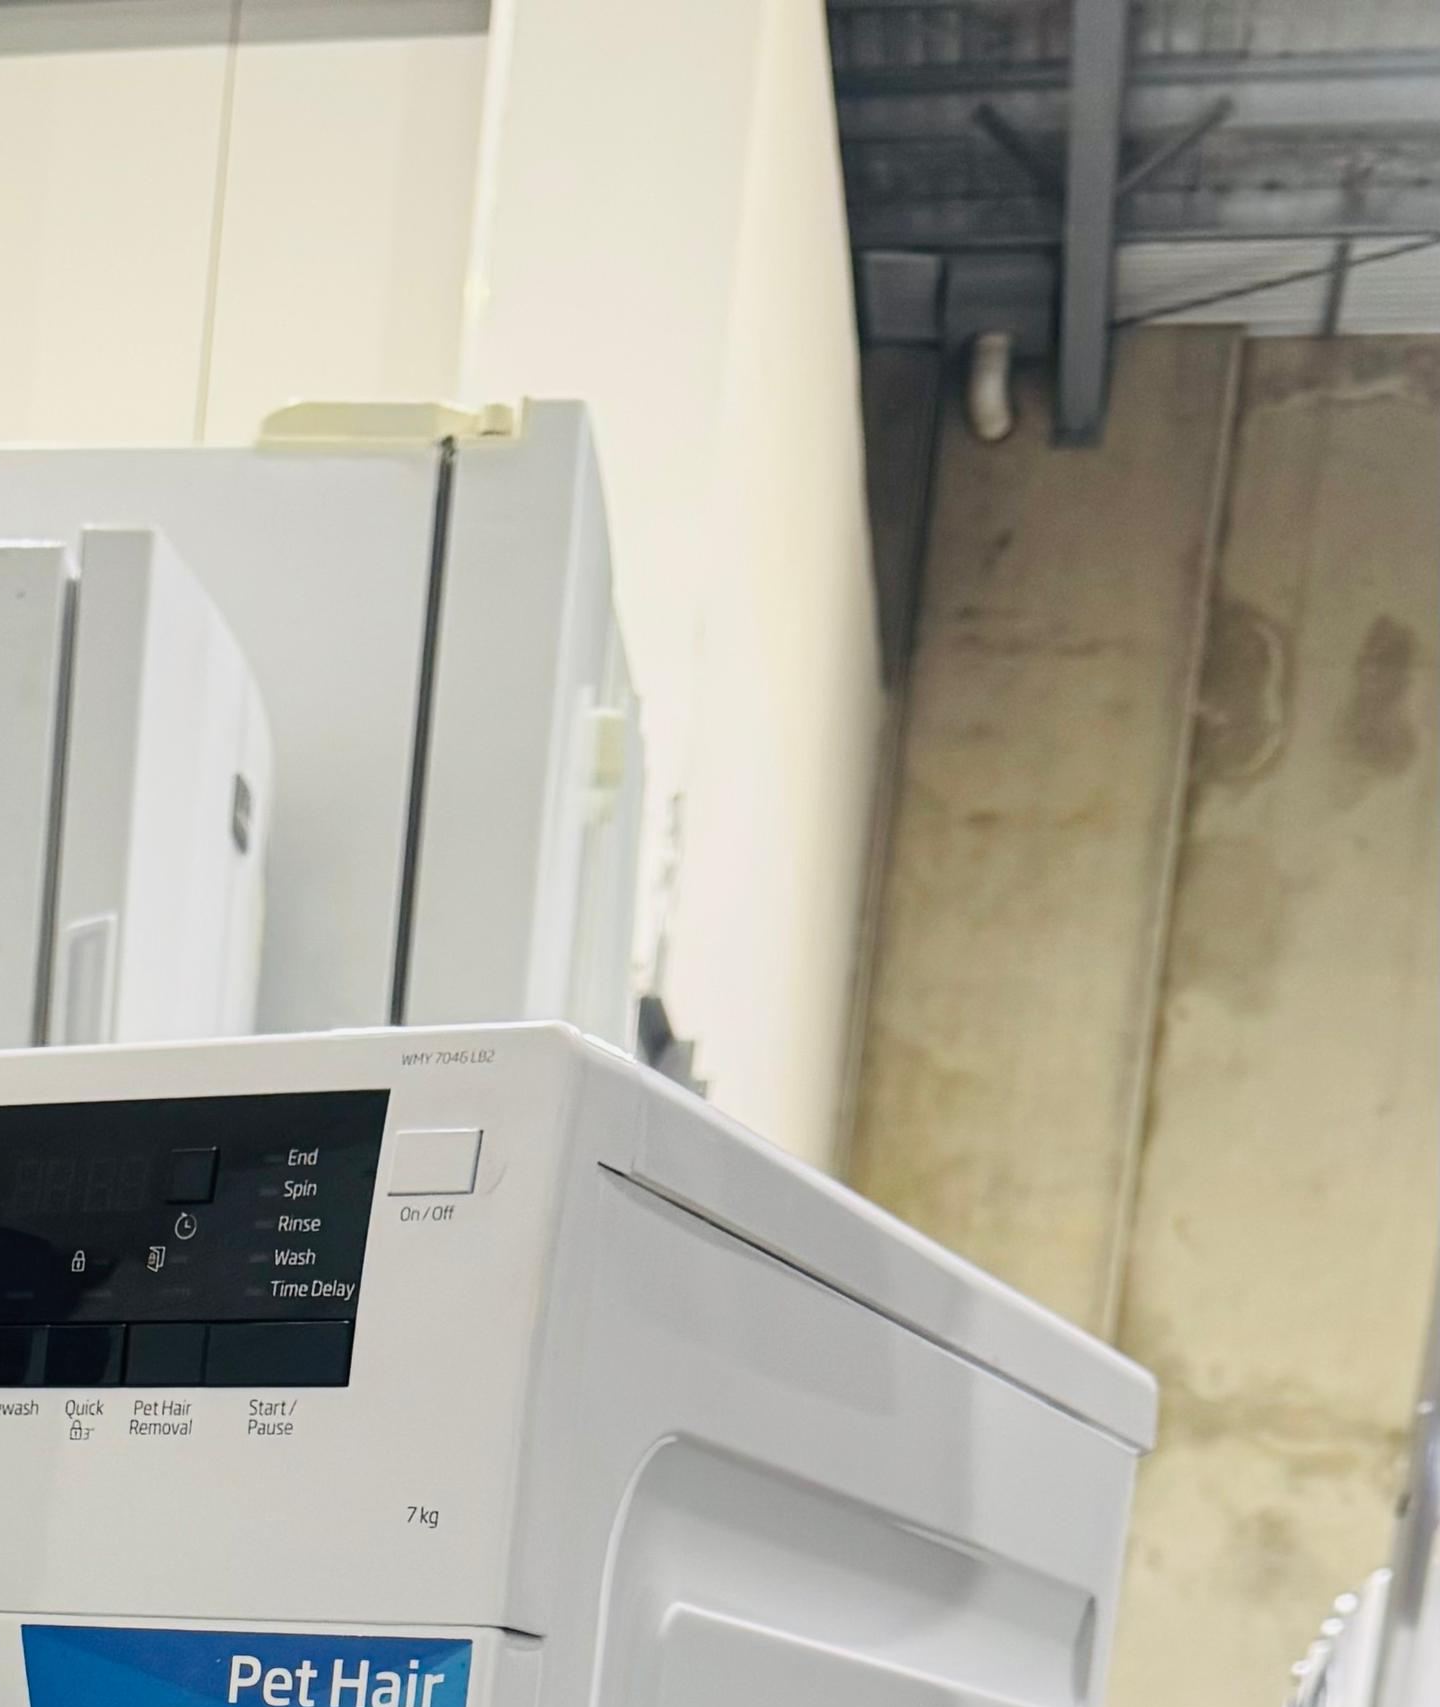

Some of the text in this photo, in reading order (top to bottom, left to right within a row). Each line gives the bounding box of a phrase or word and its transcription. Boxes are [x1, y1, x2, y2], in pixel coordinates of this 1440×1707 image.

[401, 1052, 433, 1066] WMY
[287, 1147, 320, 1167] End
[283, 1180, 318, 1200] Spin
[399, 1204, 456, 1222] On / Off
[277, 1214, 322, 1233] Rinse
[274, 1248, 316, 1266] Wash
[270, 1279, 356, 1301] Time Delay
[64, 1399, 105, 1419] Quick
[133, 1399, 193, 1416] Pet Hair
[248, 1398, 299, 1417] Start /
[129, 1419, 194, 1436] Removal
[247, 1419, 294, 1436] Pause
[407, 1506, 439, 1529] 7 kg
